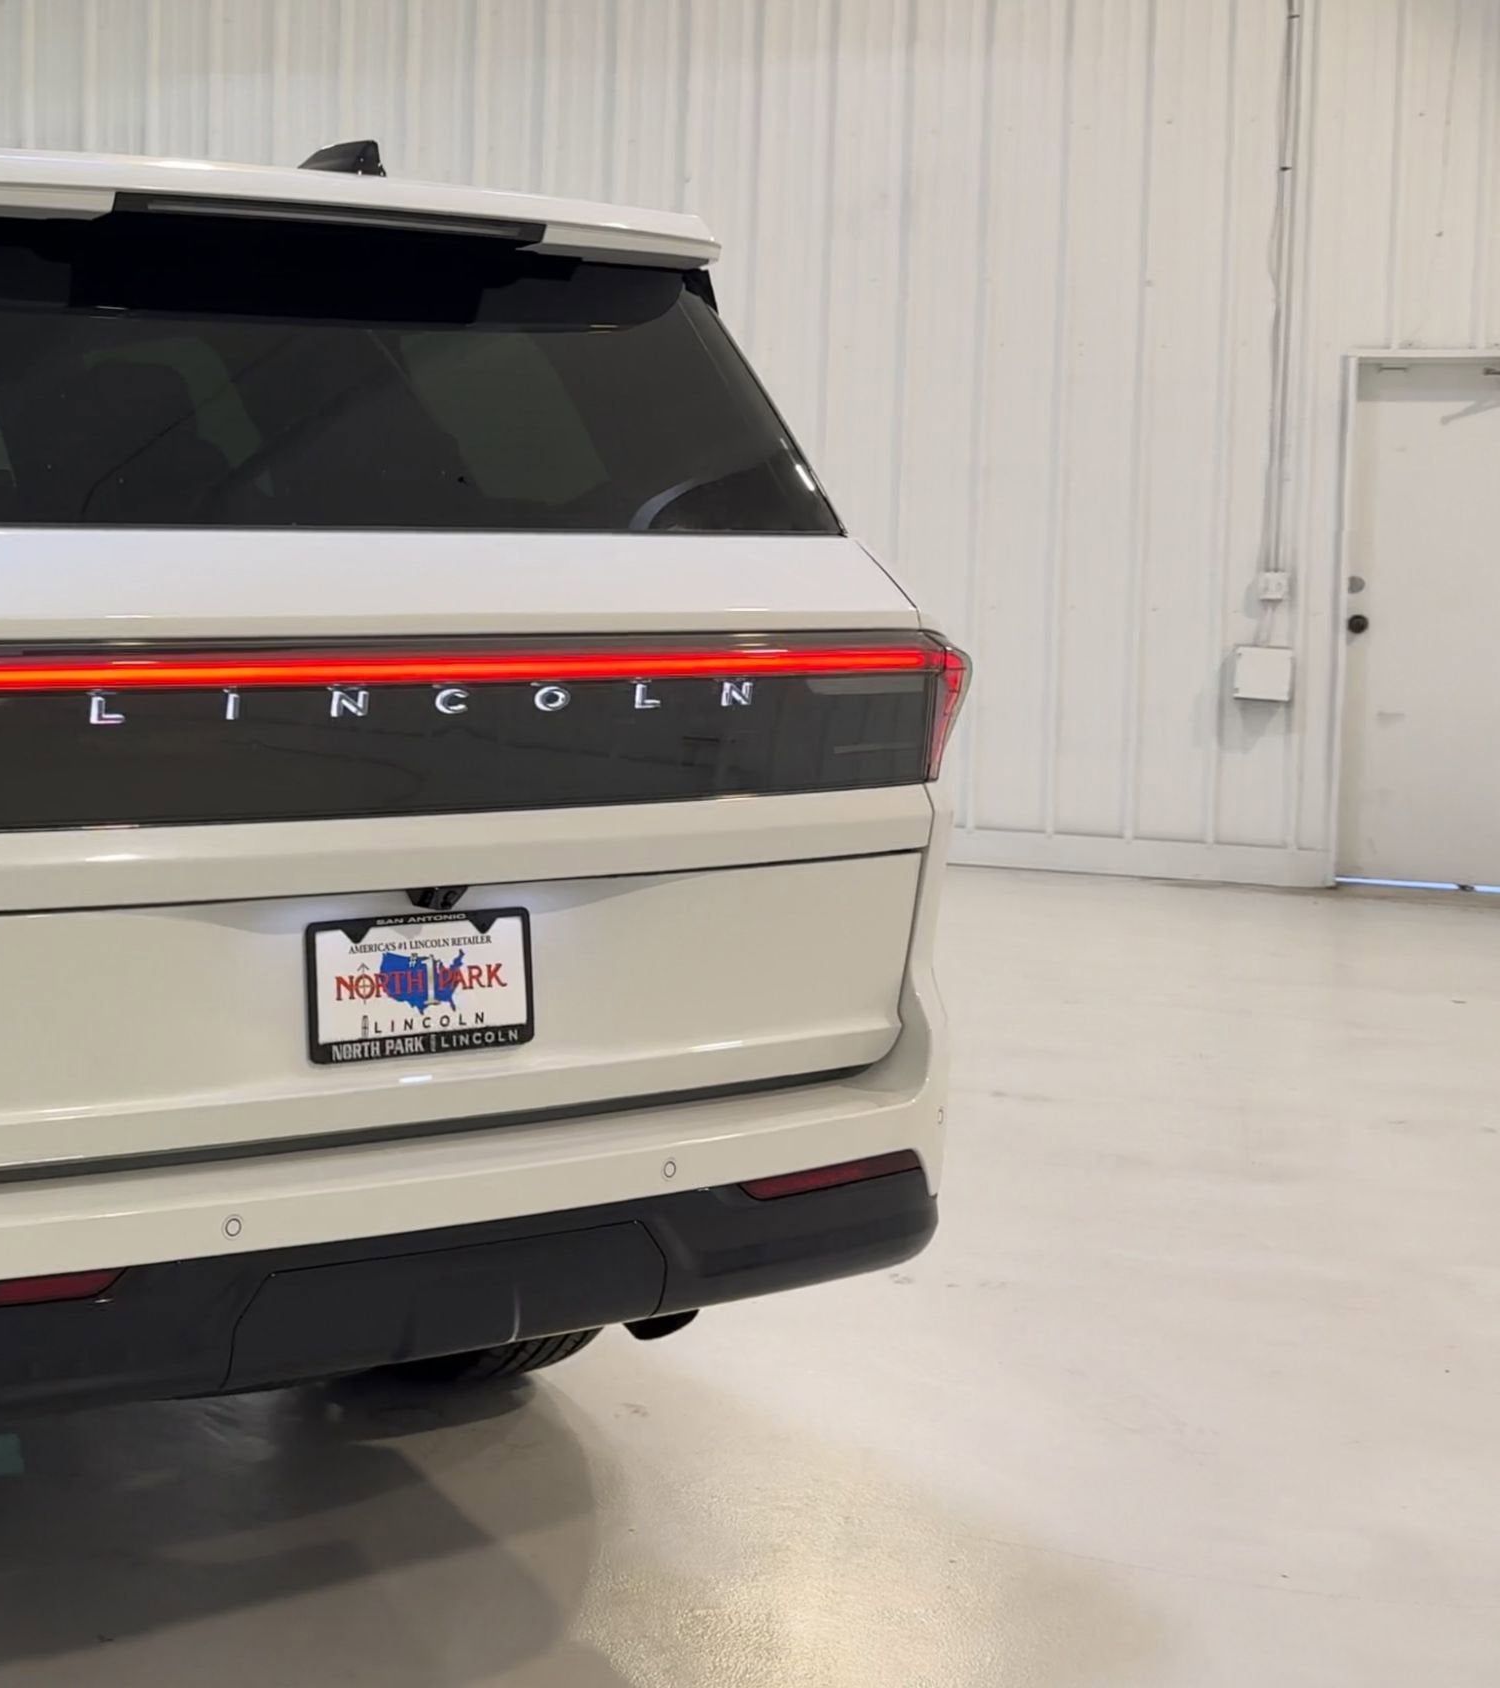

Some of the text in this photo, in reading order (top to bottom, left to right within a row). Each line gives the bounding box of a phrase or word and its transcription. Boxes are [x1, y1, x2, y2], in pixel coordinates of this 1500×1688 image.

[88, 681, 754, 725] LINCOLN
[376, 912, 467, 926] SAN ANTONIO
[349, 942, 397, 955] AMERICA'S
[409, 937, 450, 950] LINCOLN
[451, 935, 492, 947] RETAILER
[335, 963, 508, 1002] NORTH PARK
[374, 1012, 485, 1034] LINCOLN
[332, 1029, 519, 1062] NORTH PARK LINCOLN
